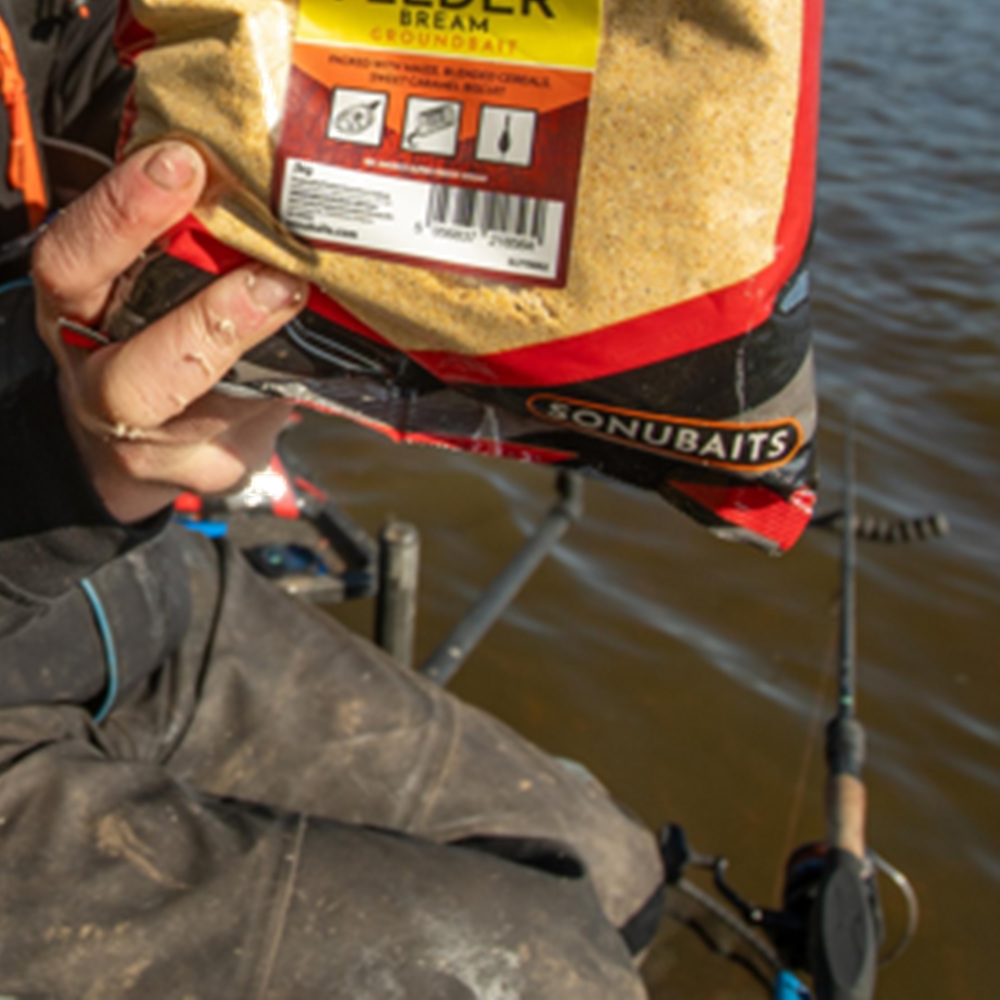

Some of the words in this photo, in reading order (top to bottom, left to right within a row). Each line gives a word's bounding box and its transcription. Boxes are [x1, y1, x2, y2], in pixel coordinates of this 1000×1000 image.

[400, 8, 489, 33] BREAM
[369, 27, 519, 55] GROUNDBAIT
[549, 401, 789, 460] SONUBAITS
